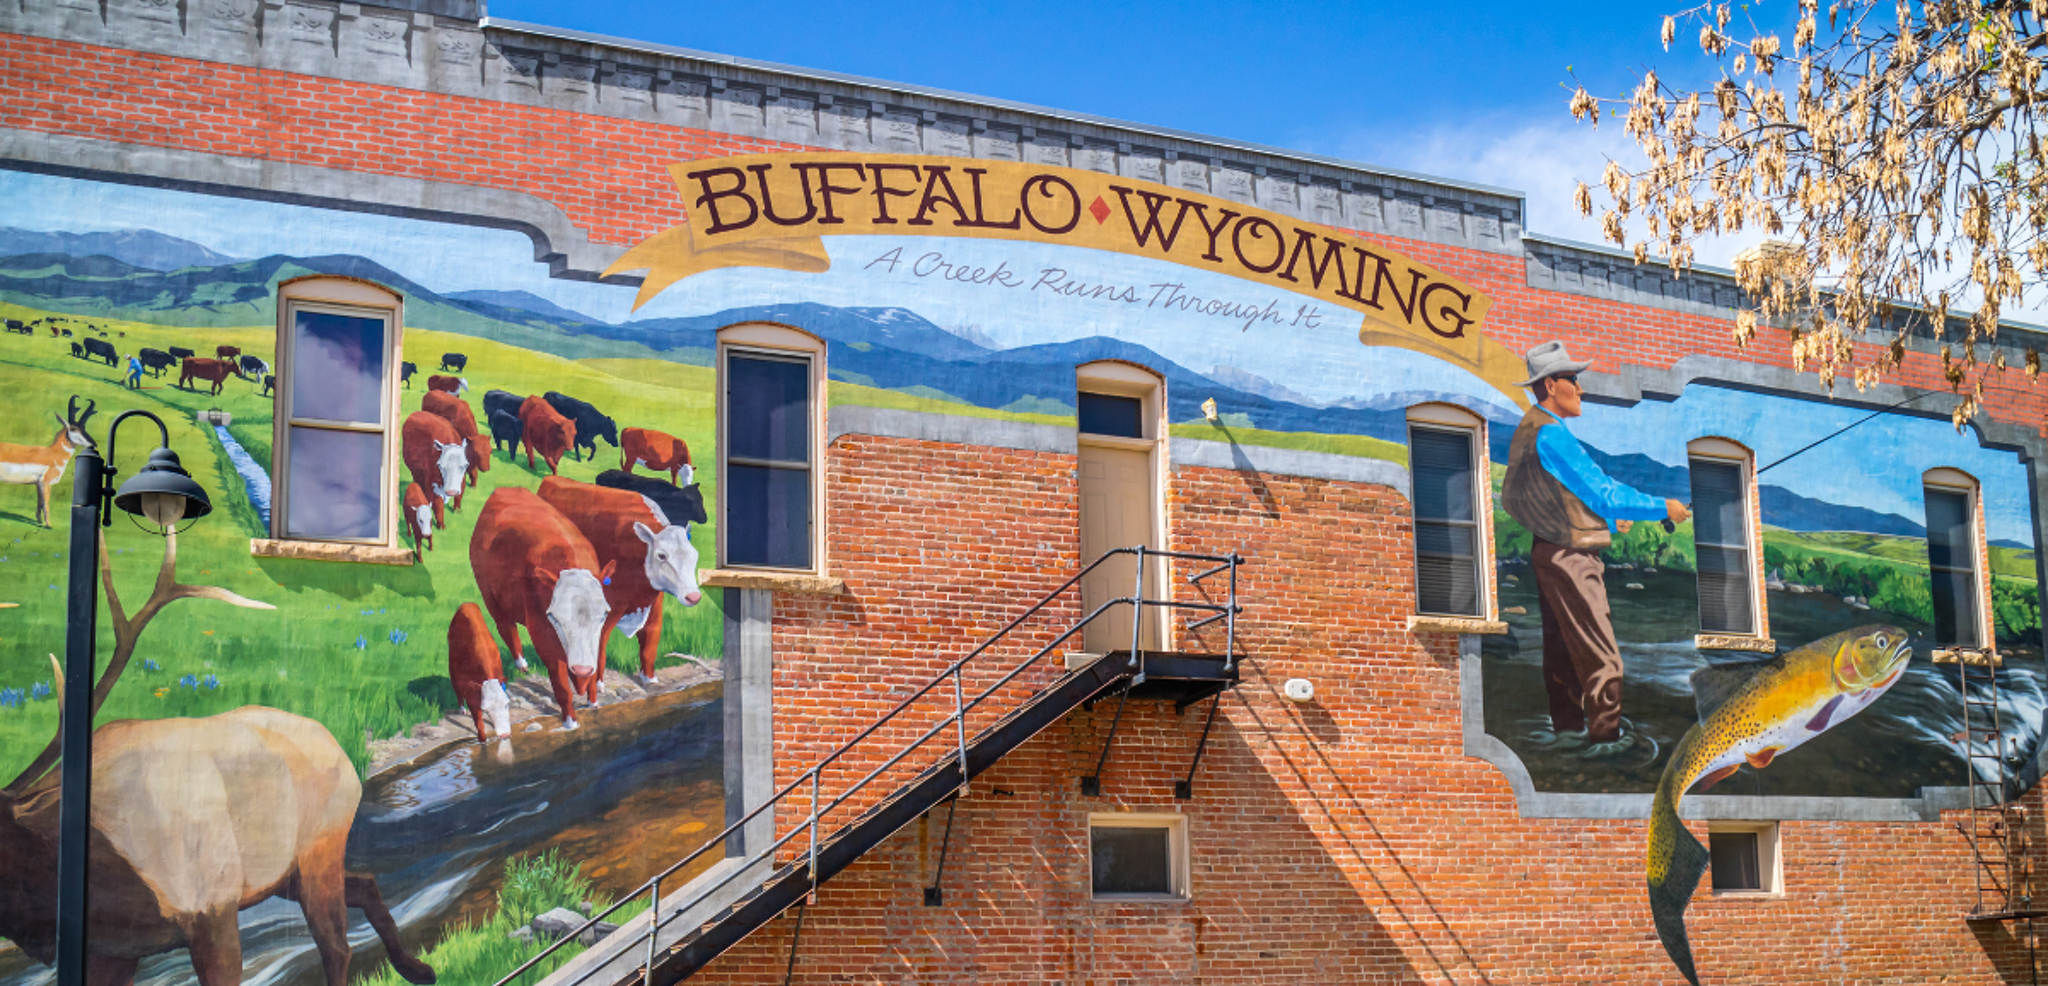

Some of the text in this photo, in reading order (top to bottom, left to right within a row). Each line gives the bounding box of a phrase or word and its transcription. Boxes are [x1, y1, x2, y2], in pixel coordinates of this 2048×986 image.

[687, 163, 1475, 339] BUFFALO WYOMING
[864, 246, 1321, 332] A Creek Runs Through It
